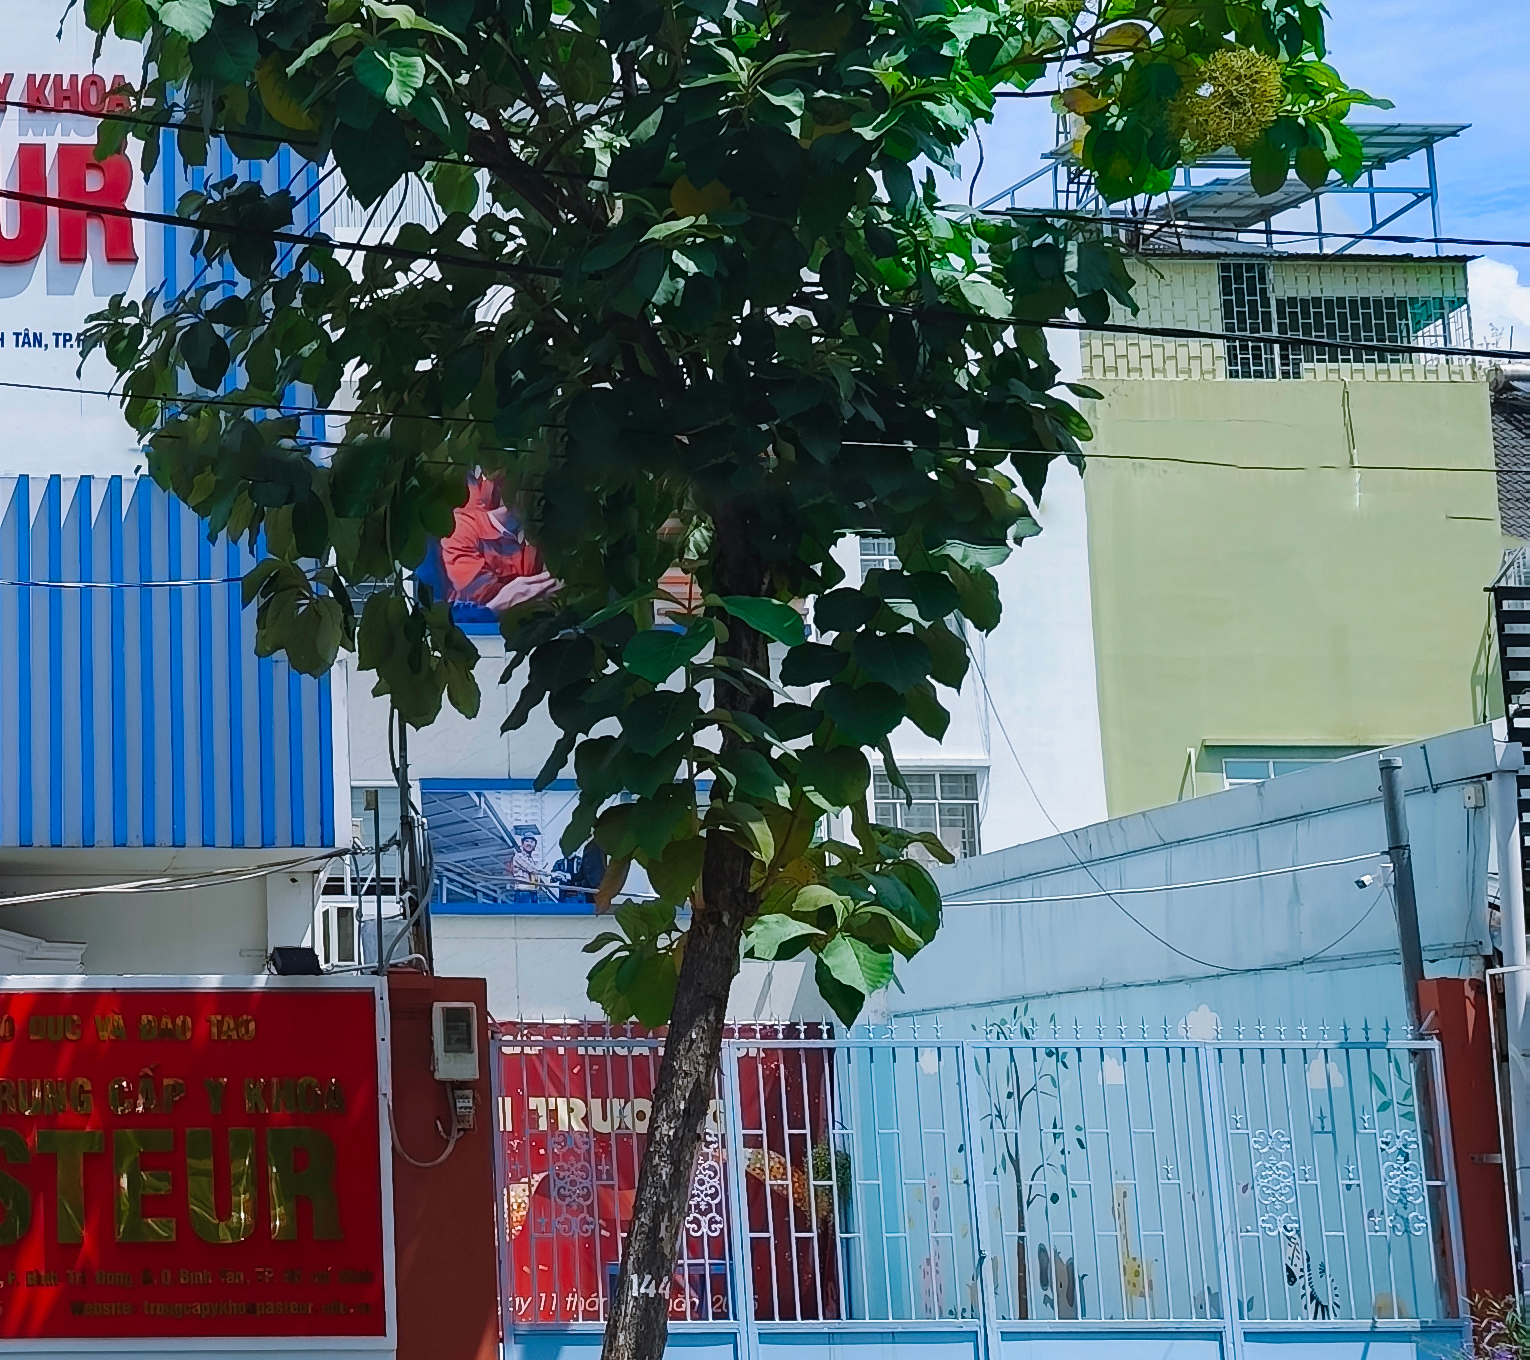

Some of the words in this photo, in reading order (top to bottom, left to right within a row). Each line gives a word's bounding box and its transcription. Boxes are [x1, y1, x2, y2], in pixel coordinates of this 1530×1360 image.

[26, 72, 133, 114] KHOA
[12, 328, 48, 351] TÂN,
[108, 1062, 186, 1115] CẤP
[203, 1076, 229, 1115] Y
[244, 1076, 347, 1116] KHOA
